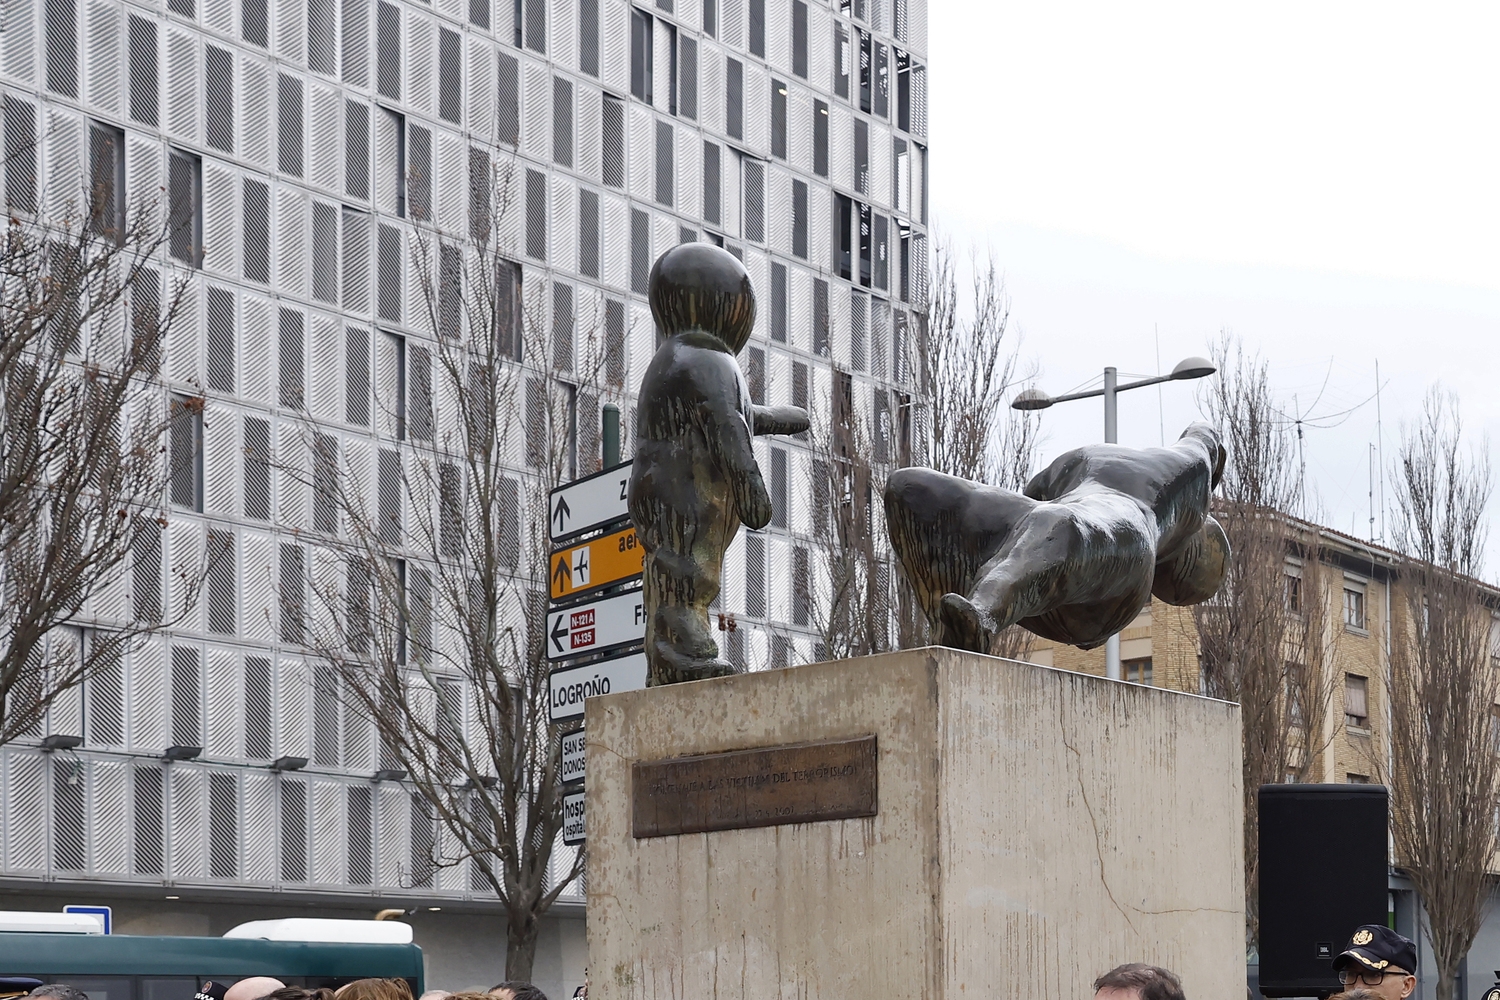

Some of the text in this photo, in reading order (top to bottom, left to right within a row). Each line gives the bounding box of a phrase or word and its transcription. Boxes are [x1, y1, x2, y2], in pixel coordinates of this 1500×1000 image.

[574, 631, 592, 645] N-135
[552, 674, 611, 708] LOGROÑO
[564, 739, 577, 756] SAN
[772, 771, 791, 784] DEL
[564, 800, 586, 821] hosp
